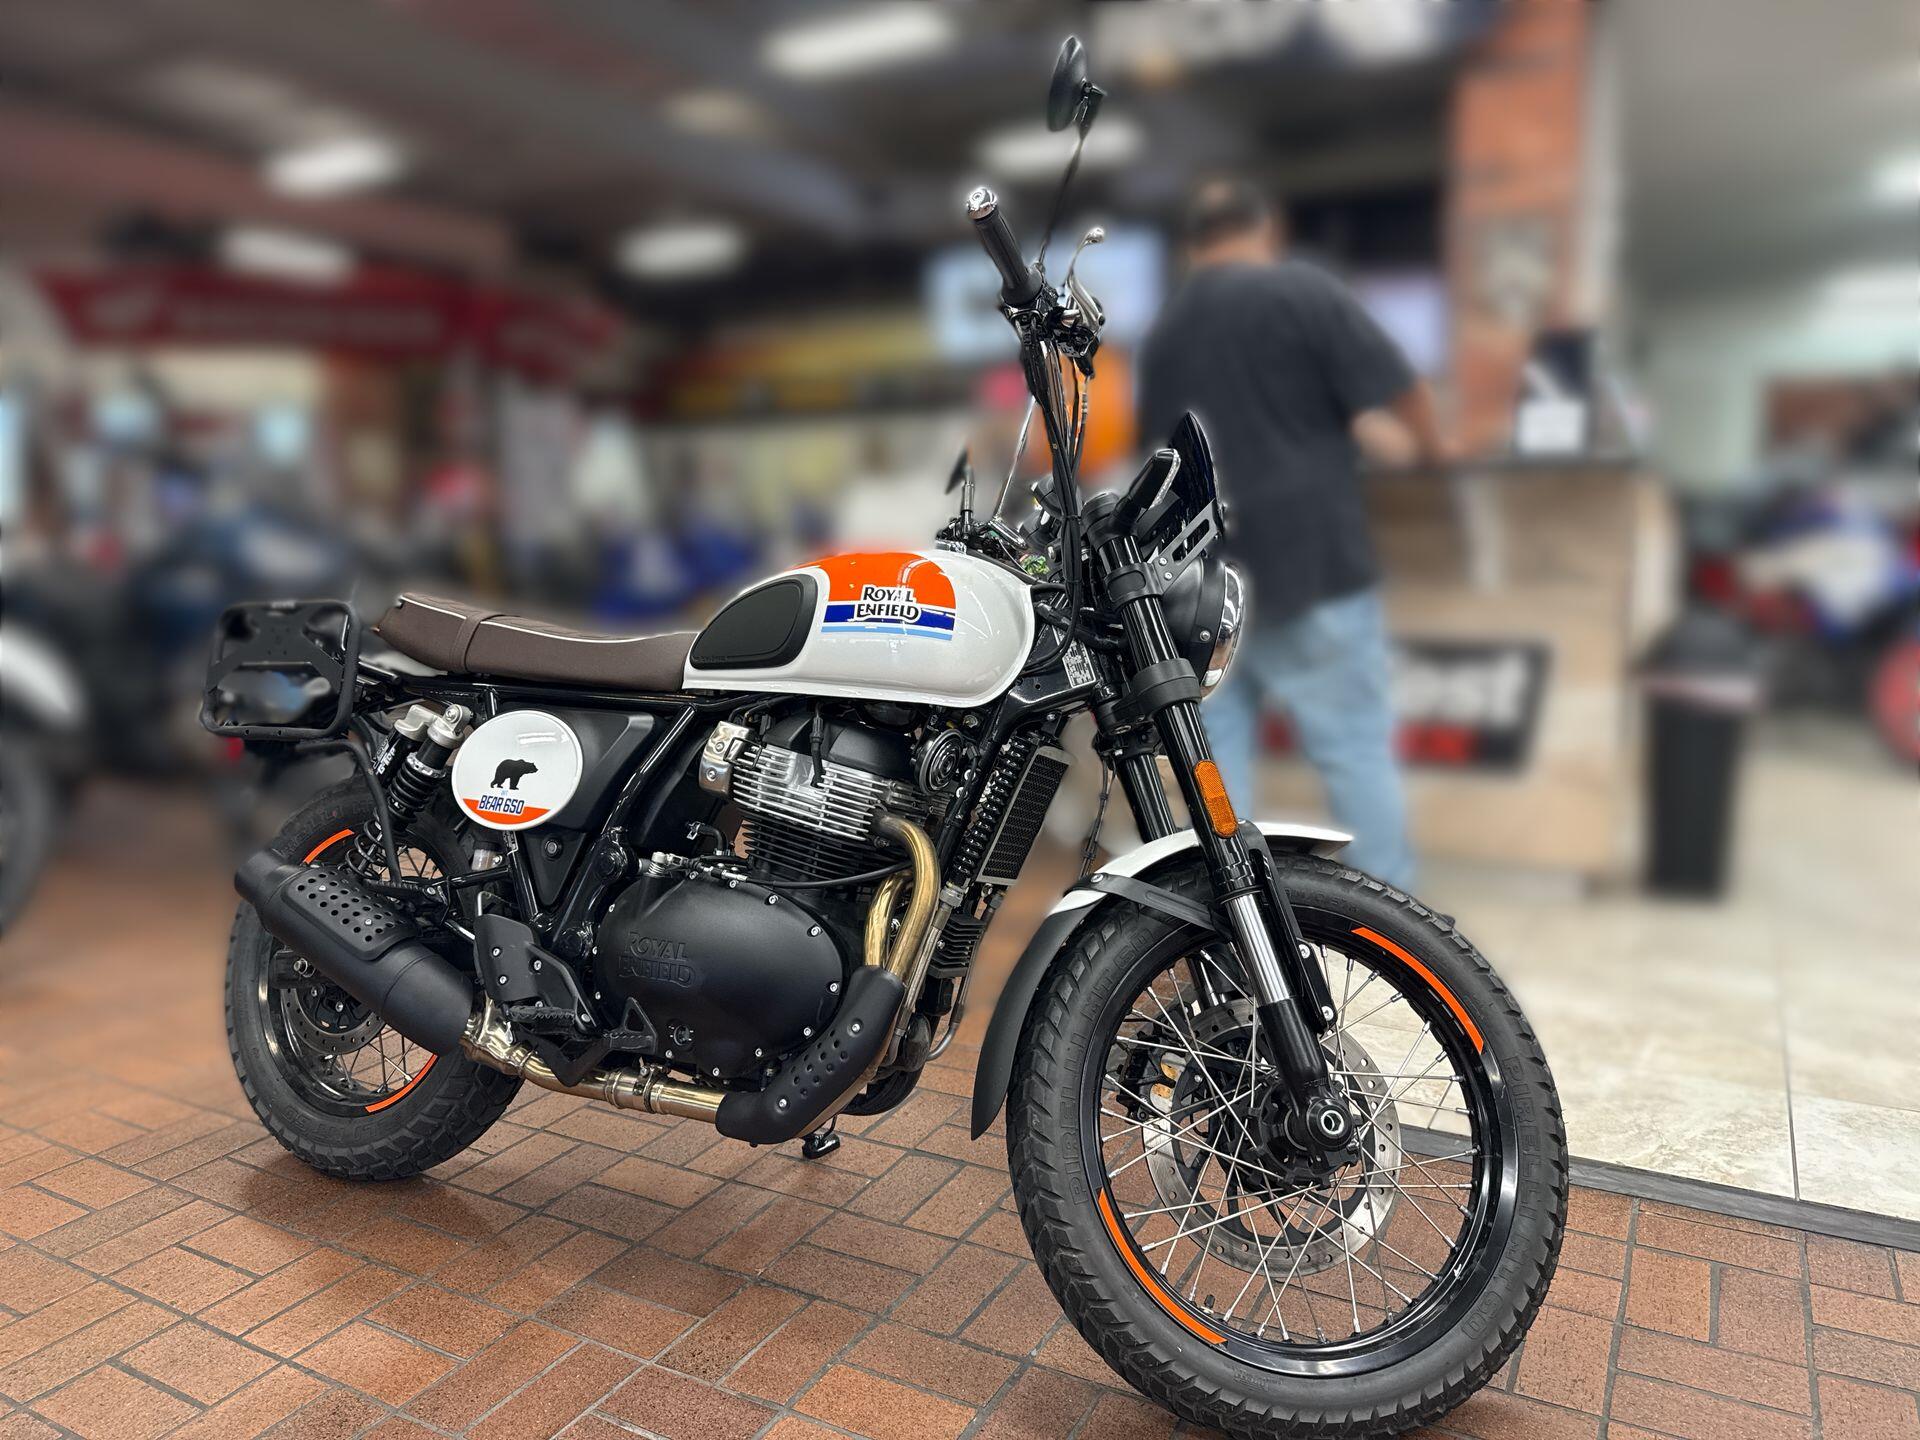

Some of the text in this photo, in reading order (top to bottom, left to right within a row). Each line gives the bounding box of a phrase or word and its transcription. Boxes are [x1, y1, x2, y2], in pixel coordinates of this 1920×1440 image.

[857, 603, 918, 620] ENFIELD
[479, 795, 525, 815] BEAR 650
[624, 930, 688, 962] ROYAL
[618, 955, 696, 988] ENFIELD
[1060, 1031, 1088, 1205] PIRELLI
[1501, 1054, 1543, 1222] PIRELLI
